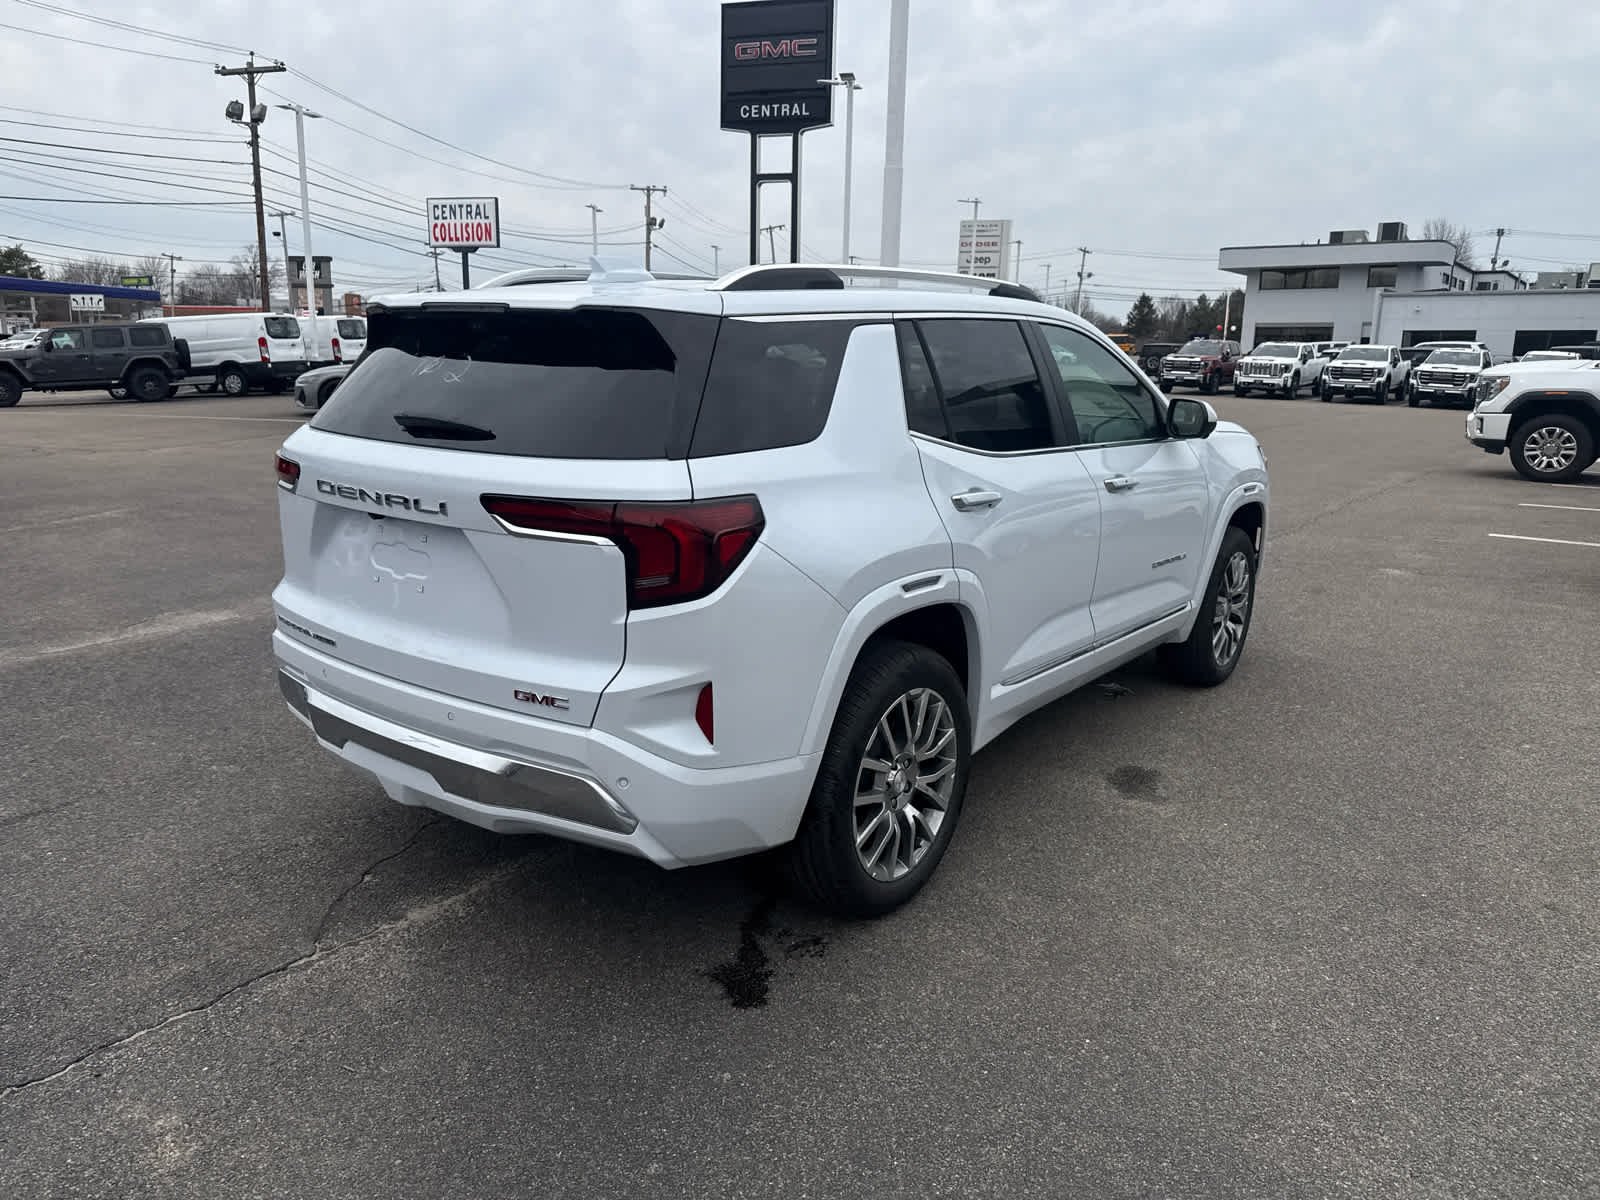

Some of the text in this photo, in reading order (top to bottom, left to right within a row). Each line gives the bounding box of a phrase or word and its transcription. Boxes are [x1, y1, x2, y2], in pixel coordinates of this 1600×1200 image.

[735, 38, 817, 60] GMC
[740, 103, 810, 118] CENTRAL
[432, 203, 490, 220] CENTRAL
[432, 222, 492, 242] COLLISION
[316, 479, 449, 517] DENALI
[513, 688, 569, 710] GMC
